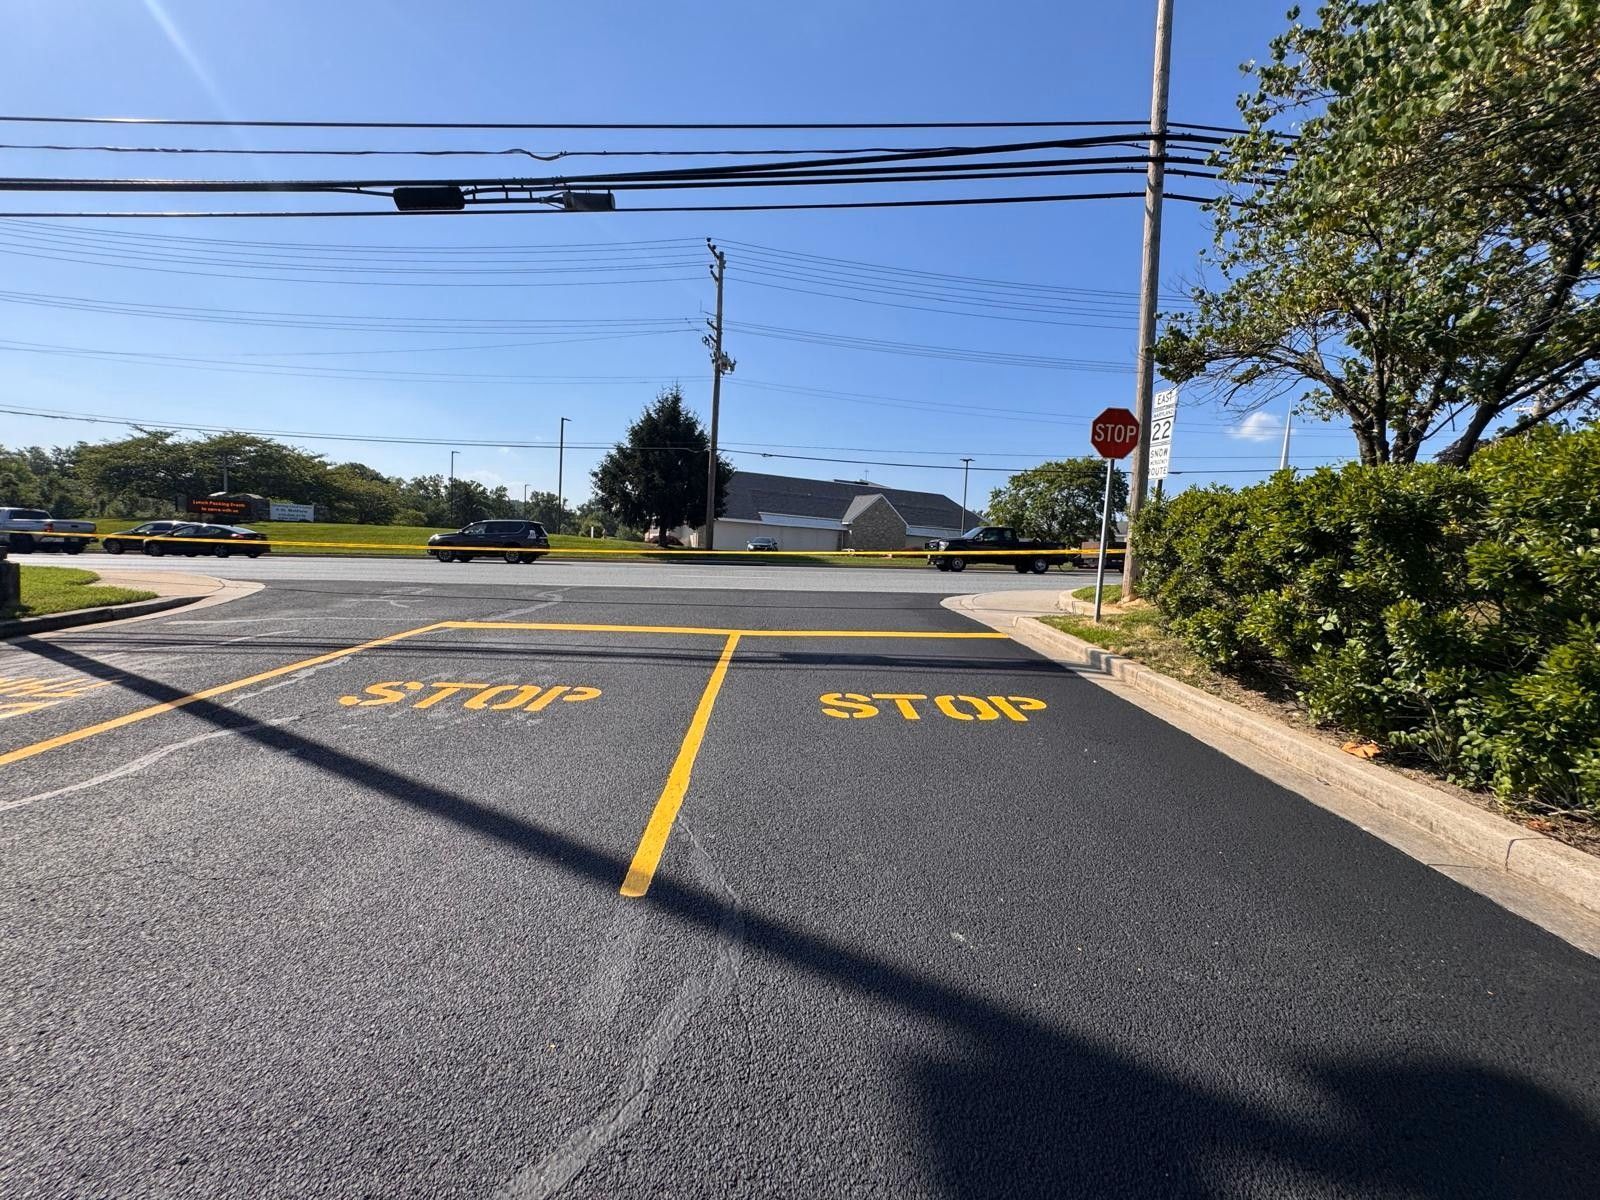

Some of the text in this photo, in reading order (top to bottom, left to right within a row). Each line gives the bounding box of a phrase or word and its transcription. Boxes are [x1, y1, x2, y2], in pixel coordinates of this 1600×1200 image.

[1157, 392, 1173, 405] EAST
[1094, 424, 1136, 443] STOP
[1152, 420, 1171, 441] 22
[1151, 448, 1168, 458] SNOW
[1149, 466, 1167, 476] OUTE
[337, 681, 602, 711] STOP
[819, 692, 1047, 721] STOP
